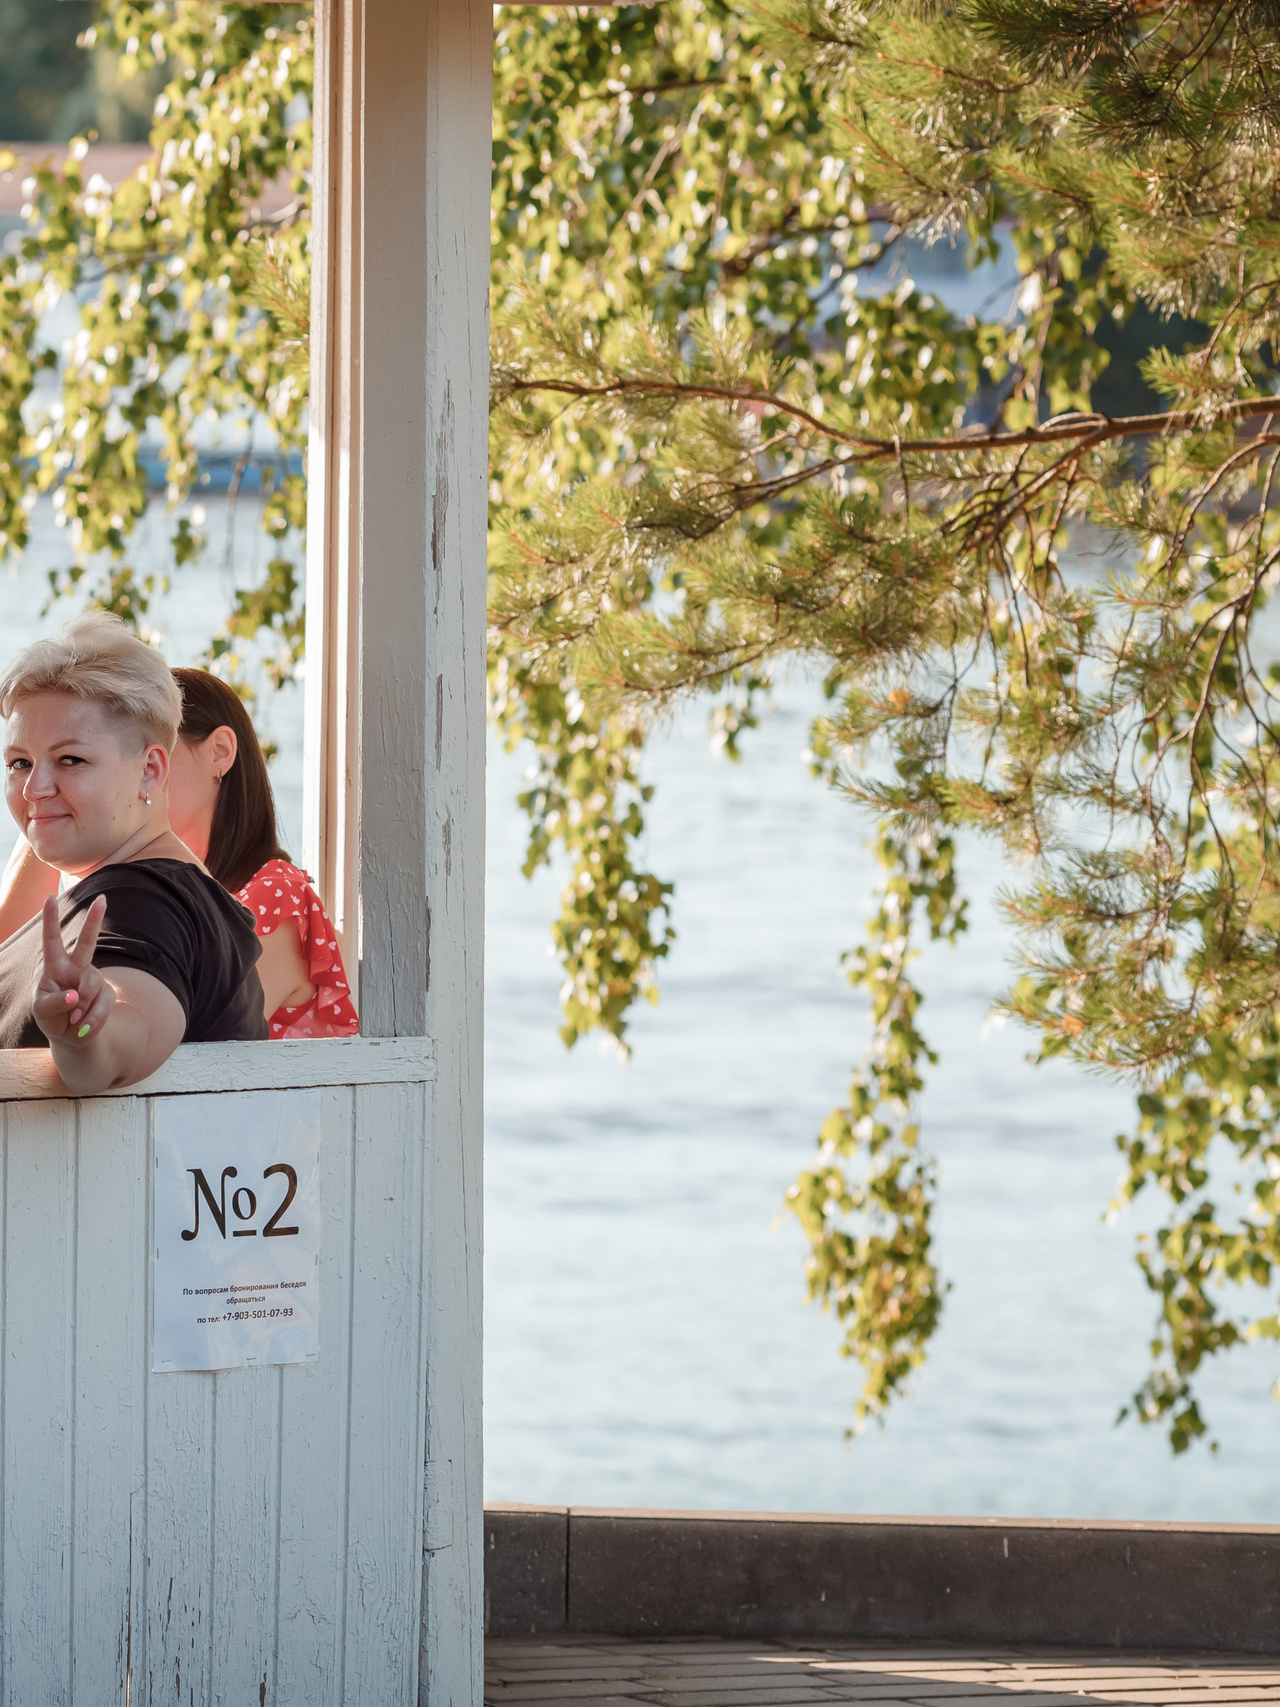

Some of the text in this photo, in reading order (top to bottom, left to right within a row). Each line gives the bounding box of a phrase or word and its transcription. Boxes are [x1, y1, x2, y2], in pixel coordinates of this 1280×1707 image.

[182, 1280, 307, 1296] По вопросам бронирования беседок
[226, 1295, 266, 1305] обращаться
[222, 1308, 293, 1321] +7-903-501-07-93
